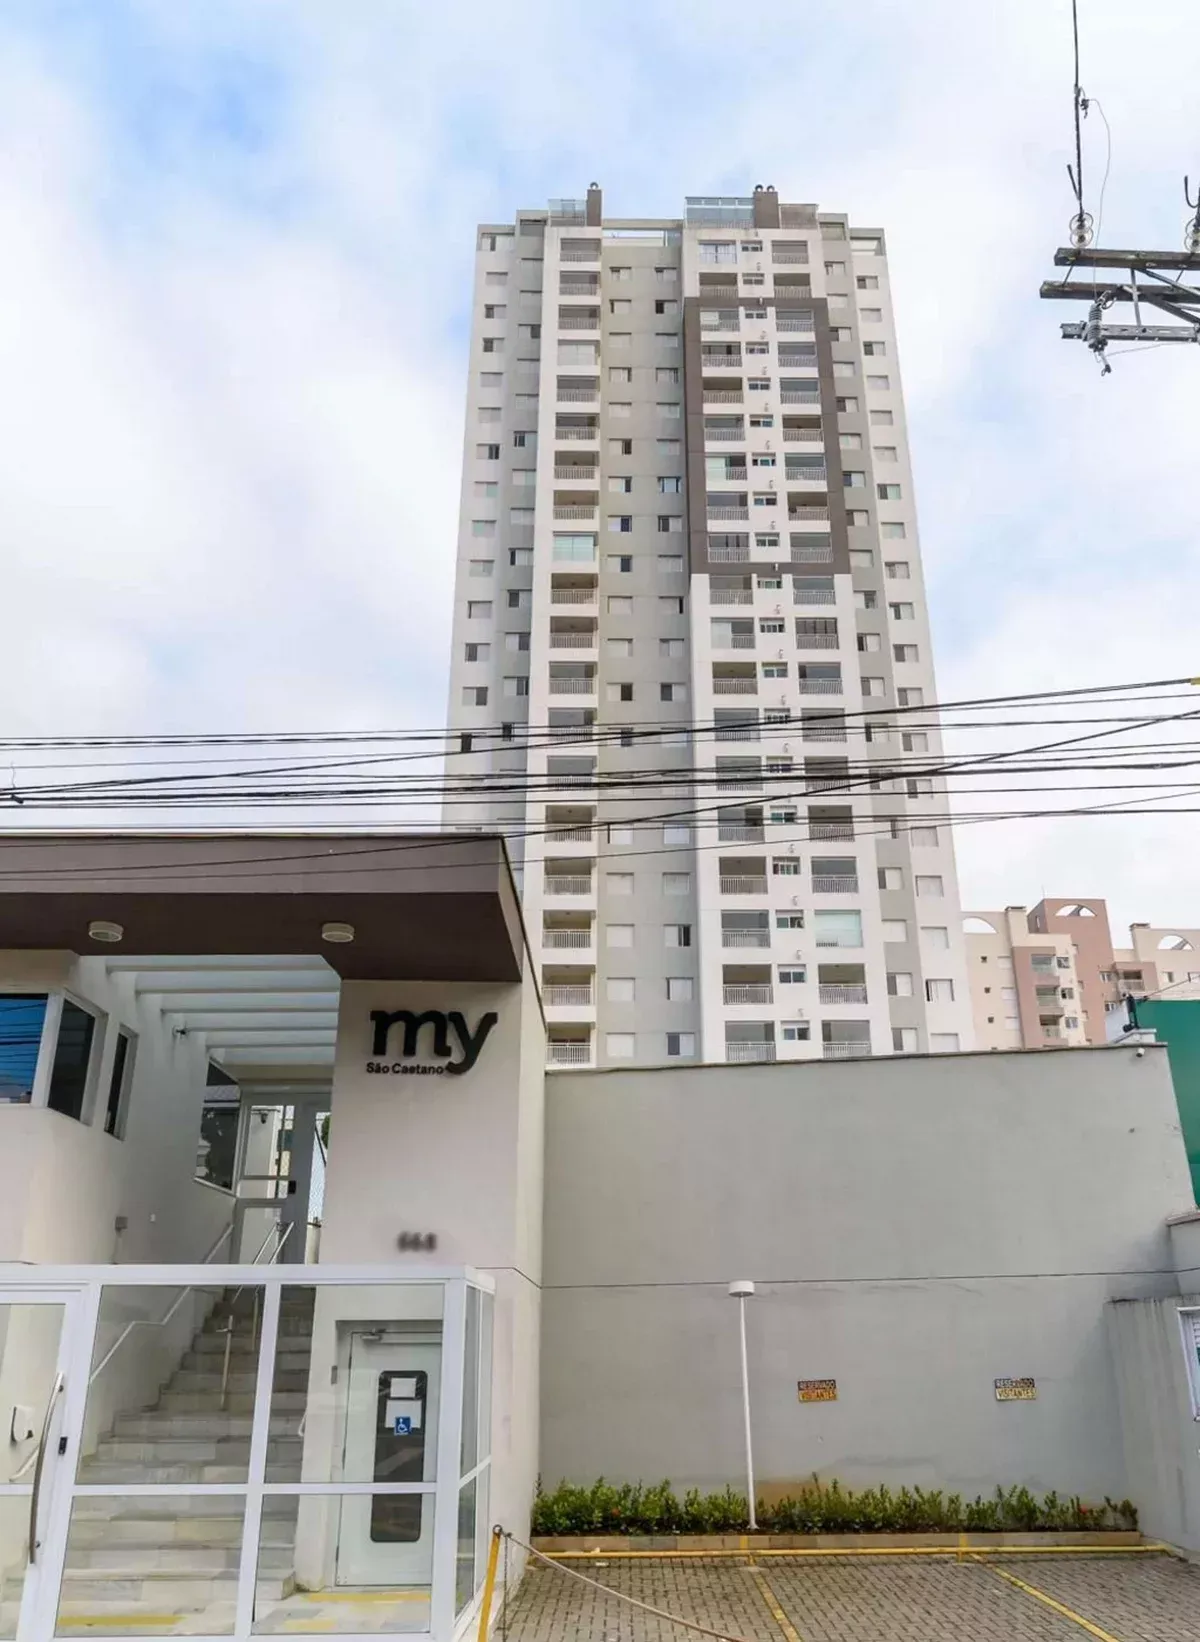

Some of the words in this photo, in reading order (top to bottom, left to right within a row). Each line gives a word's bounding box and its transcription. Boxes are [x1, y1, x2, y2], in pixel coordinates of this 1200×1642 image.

[370, 1010, 498, 1075] my
[366, 1062, 389, 1073] São
[392, 1063, 444, 1075] Caetano
[799, 1381, 835, 1389] RESERVADO
[996, 1380, 1034, 1388] RESERVADO
[800, 1390, 836, 1399] VISITANTES
[999, 1388, 1035, 1398] VISITANTES
